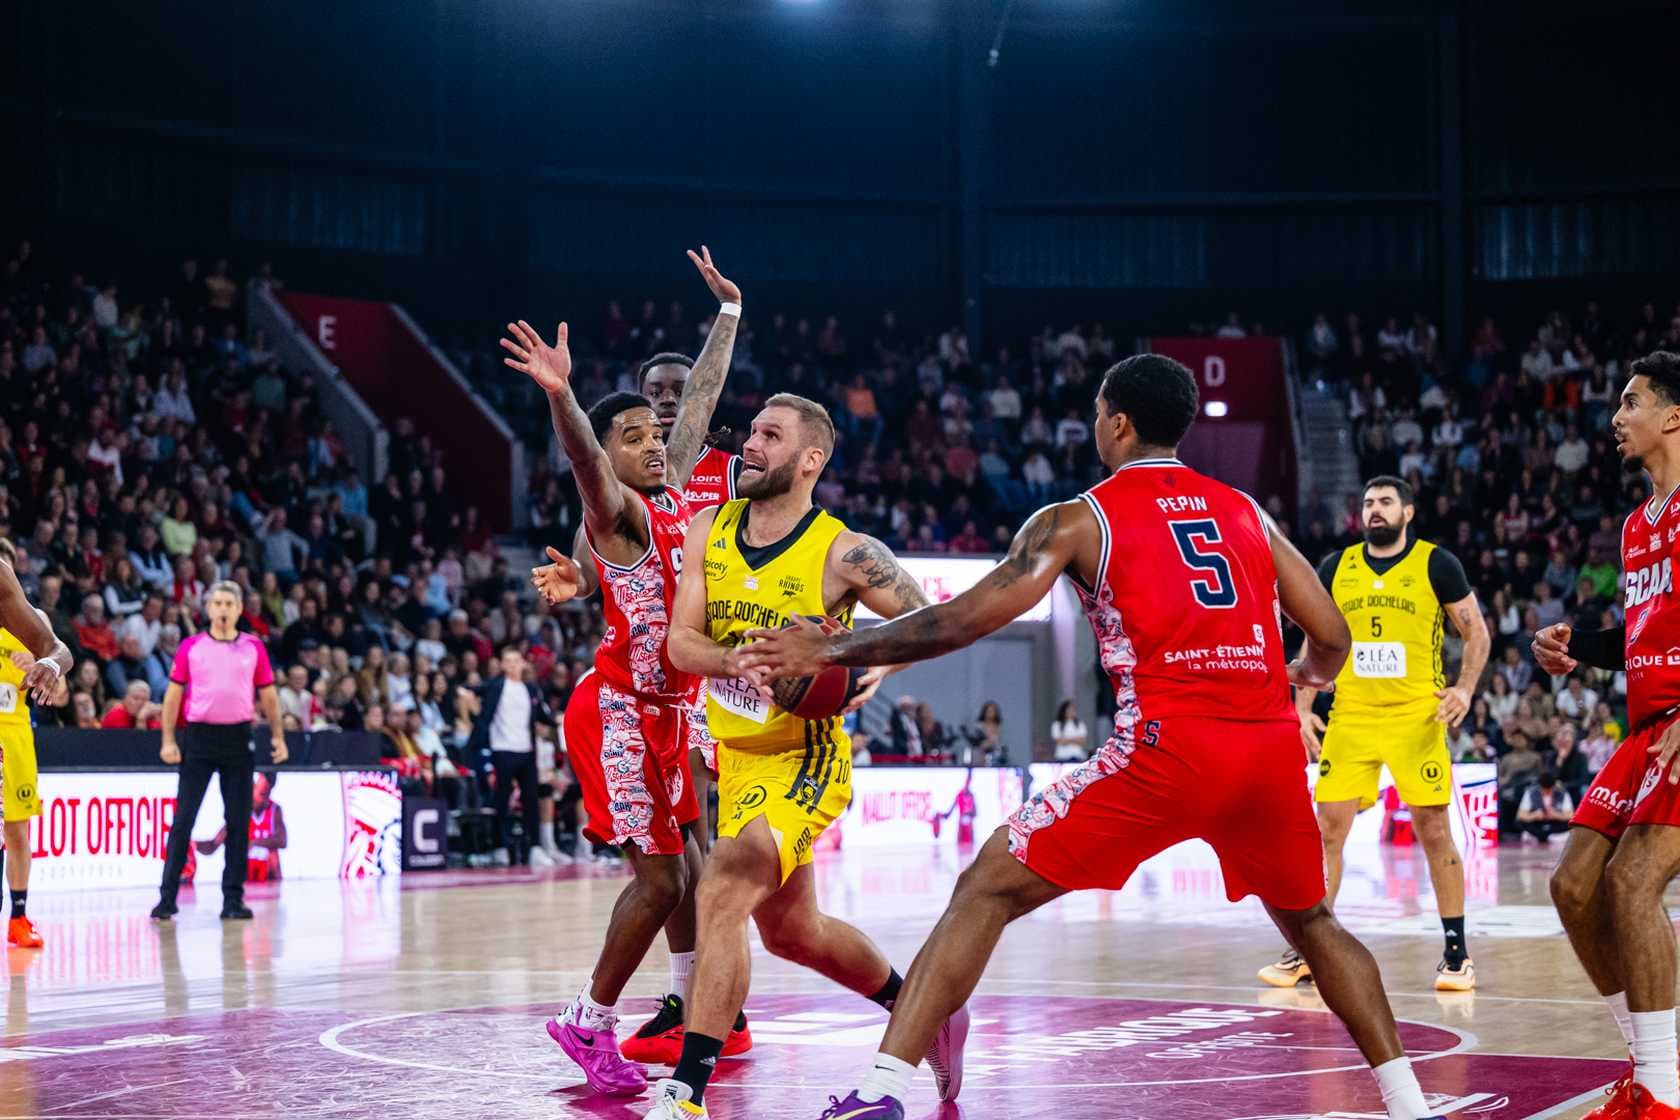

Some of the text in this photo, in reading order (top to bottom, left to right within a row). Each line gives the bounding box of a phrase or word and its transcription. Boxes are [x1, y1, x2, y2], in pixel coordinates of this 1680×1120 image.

[319, 315, 337, 350] E
[1205, 356, 1226, 387] D
[1156, 495, 1208, 514] PEPIN
[1167, 518, 1239, 609] 5
[778, 578, 806, 593] RHINOS
[1371, 616, 1383, 638] 5
[1164, 645, 1265, 664] SAINT-ÉTIENN
[1188, 658, 1268, 673] la métropo
[715, 681, 761, 714] NATURE
[1143, 719, 1161, 747] S
[835, 758, 850, 785] 10
[1426, 767, 1438, 778] U
[413, 808, 439, 853] C
